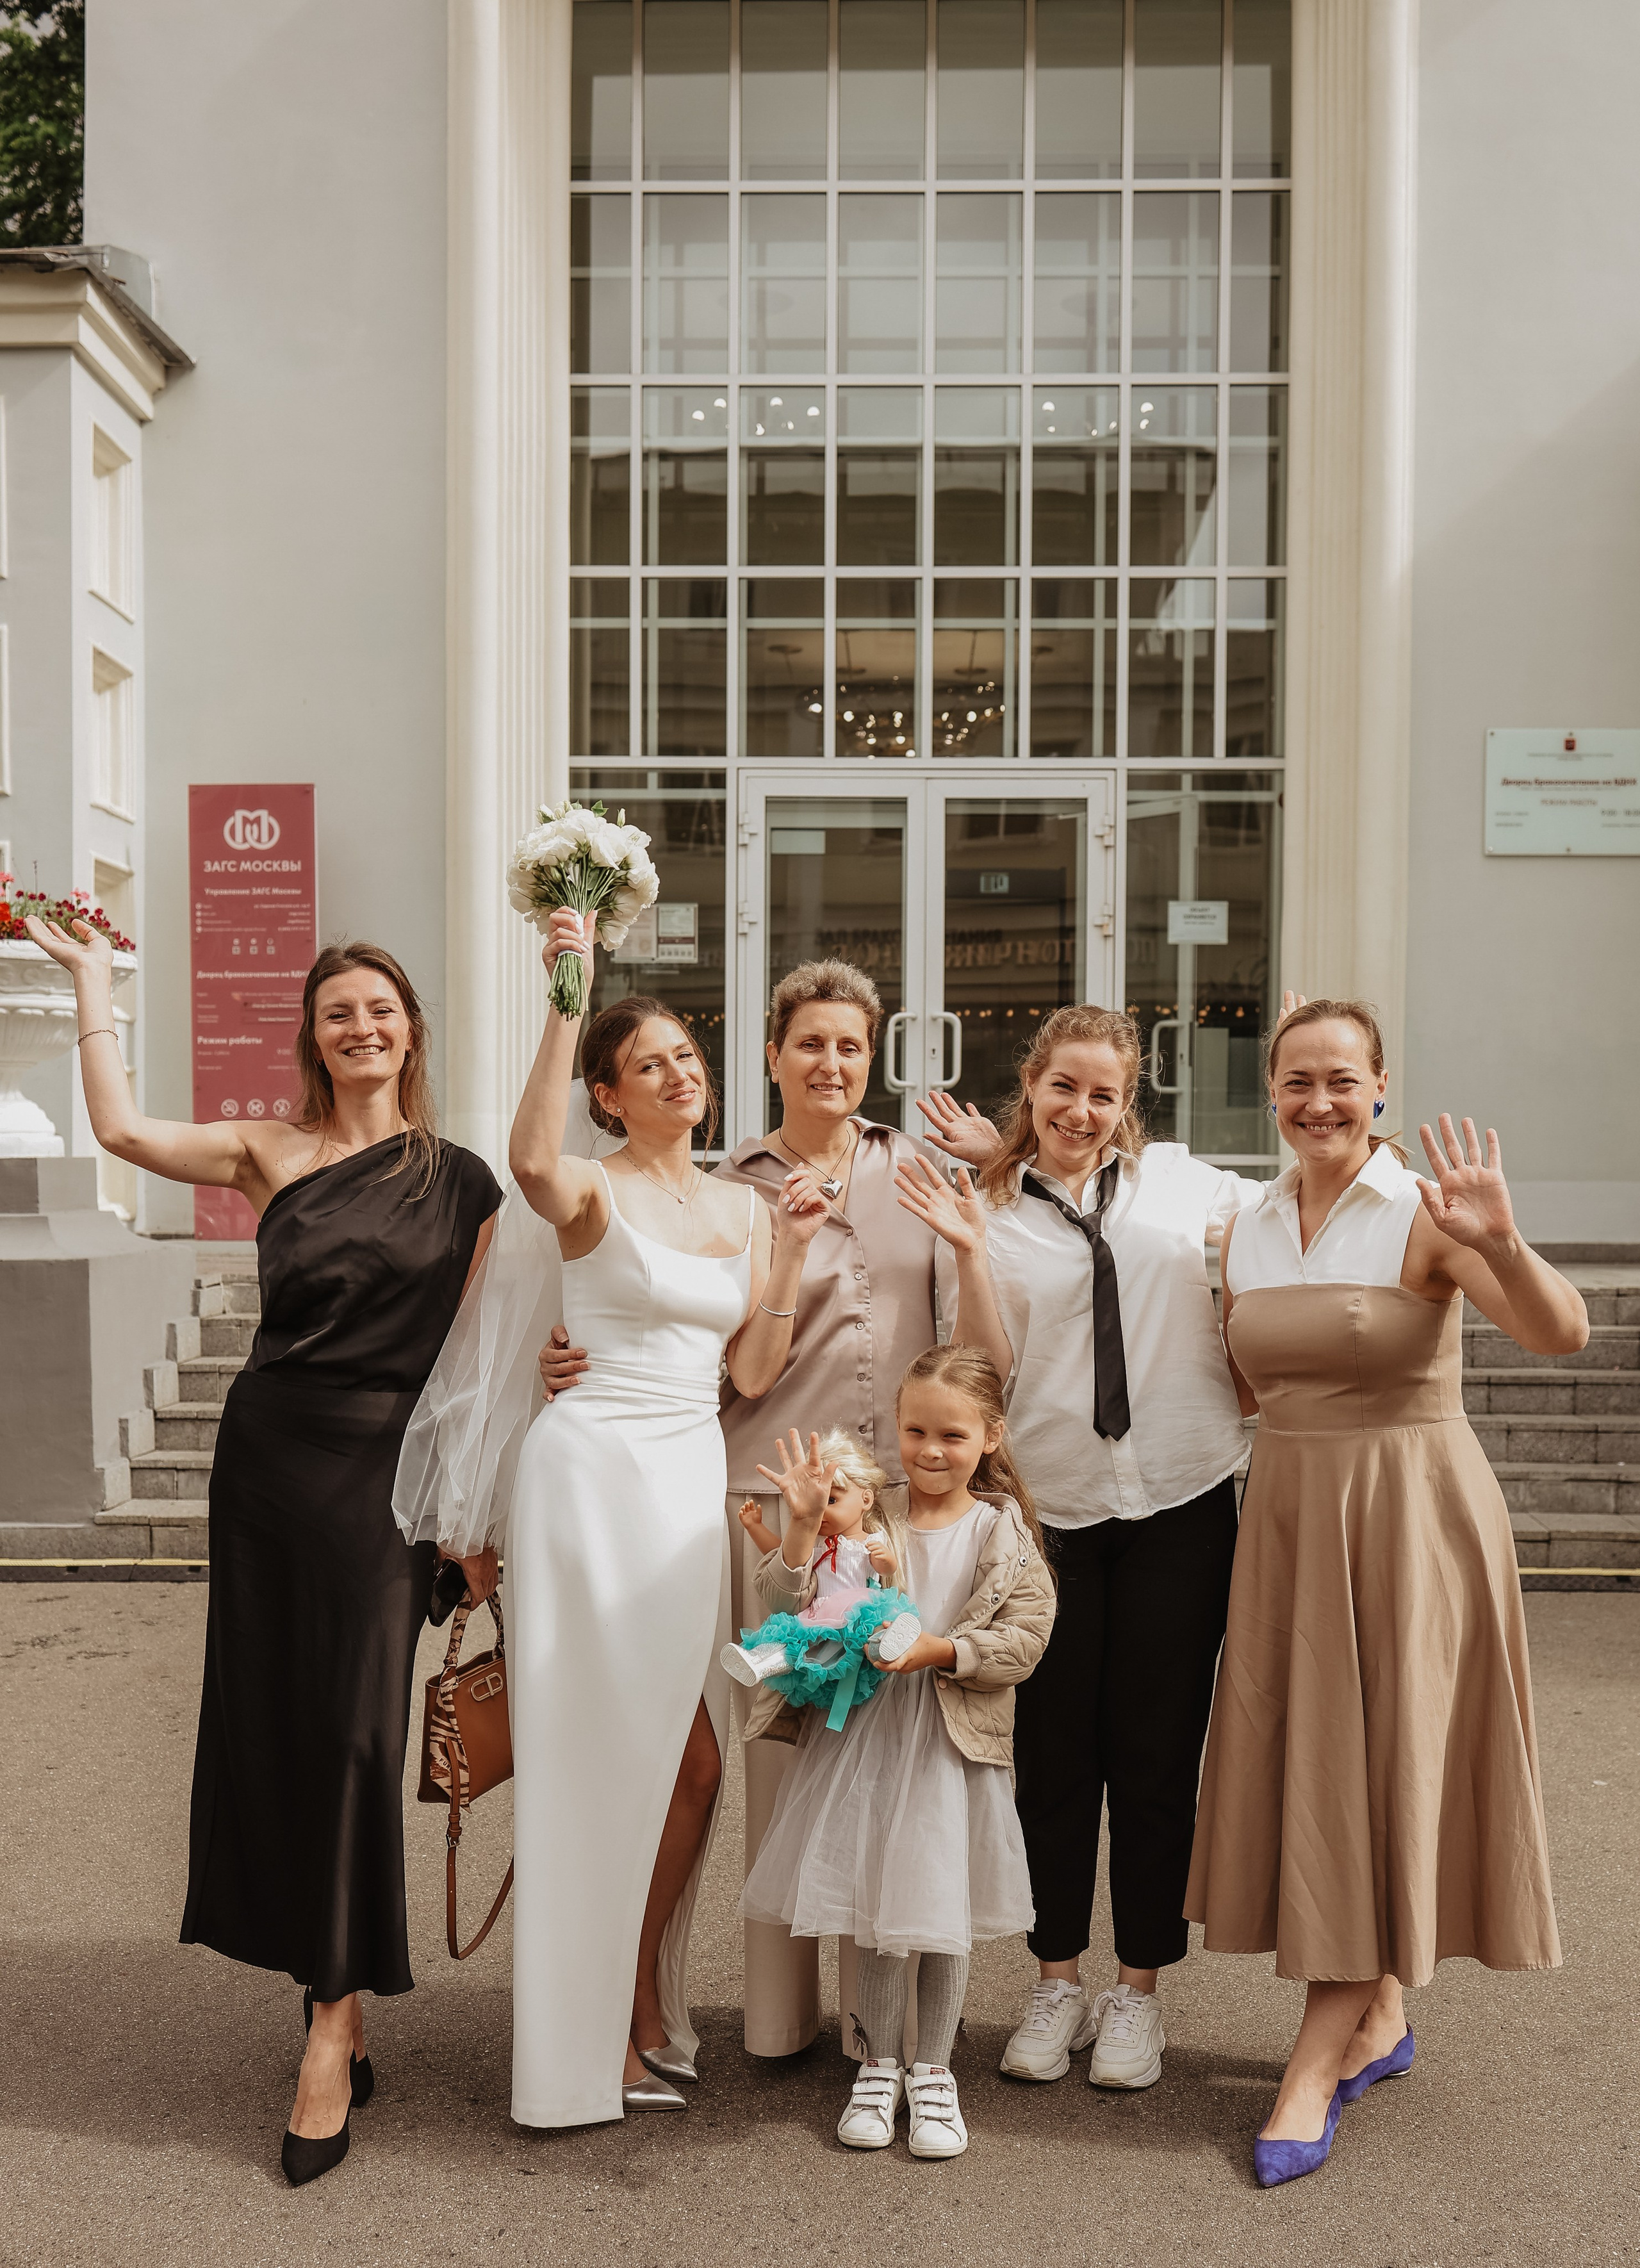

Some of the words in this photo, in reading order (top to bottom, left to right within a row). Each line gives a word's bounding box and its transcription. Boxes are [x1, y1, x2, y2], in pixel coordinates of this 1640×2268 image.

[203, 860, 237, 873] ЗАГС
[240, 860, 302, 872] МОСКВЫ
[197, 971, 223, 979] Дворец
[197, 1036, 227, 1044] Режим
[229, 1035, 263, 1046] работы
